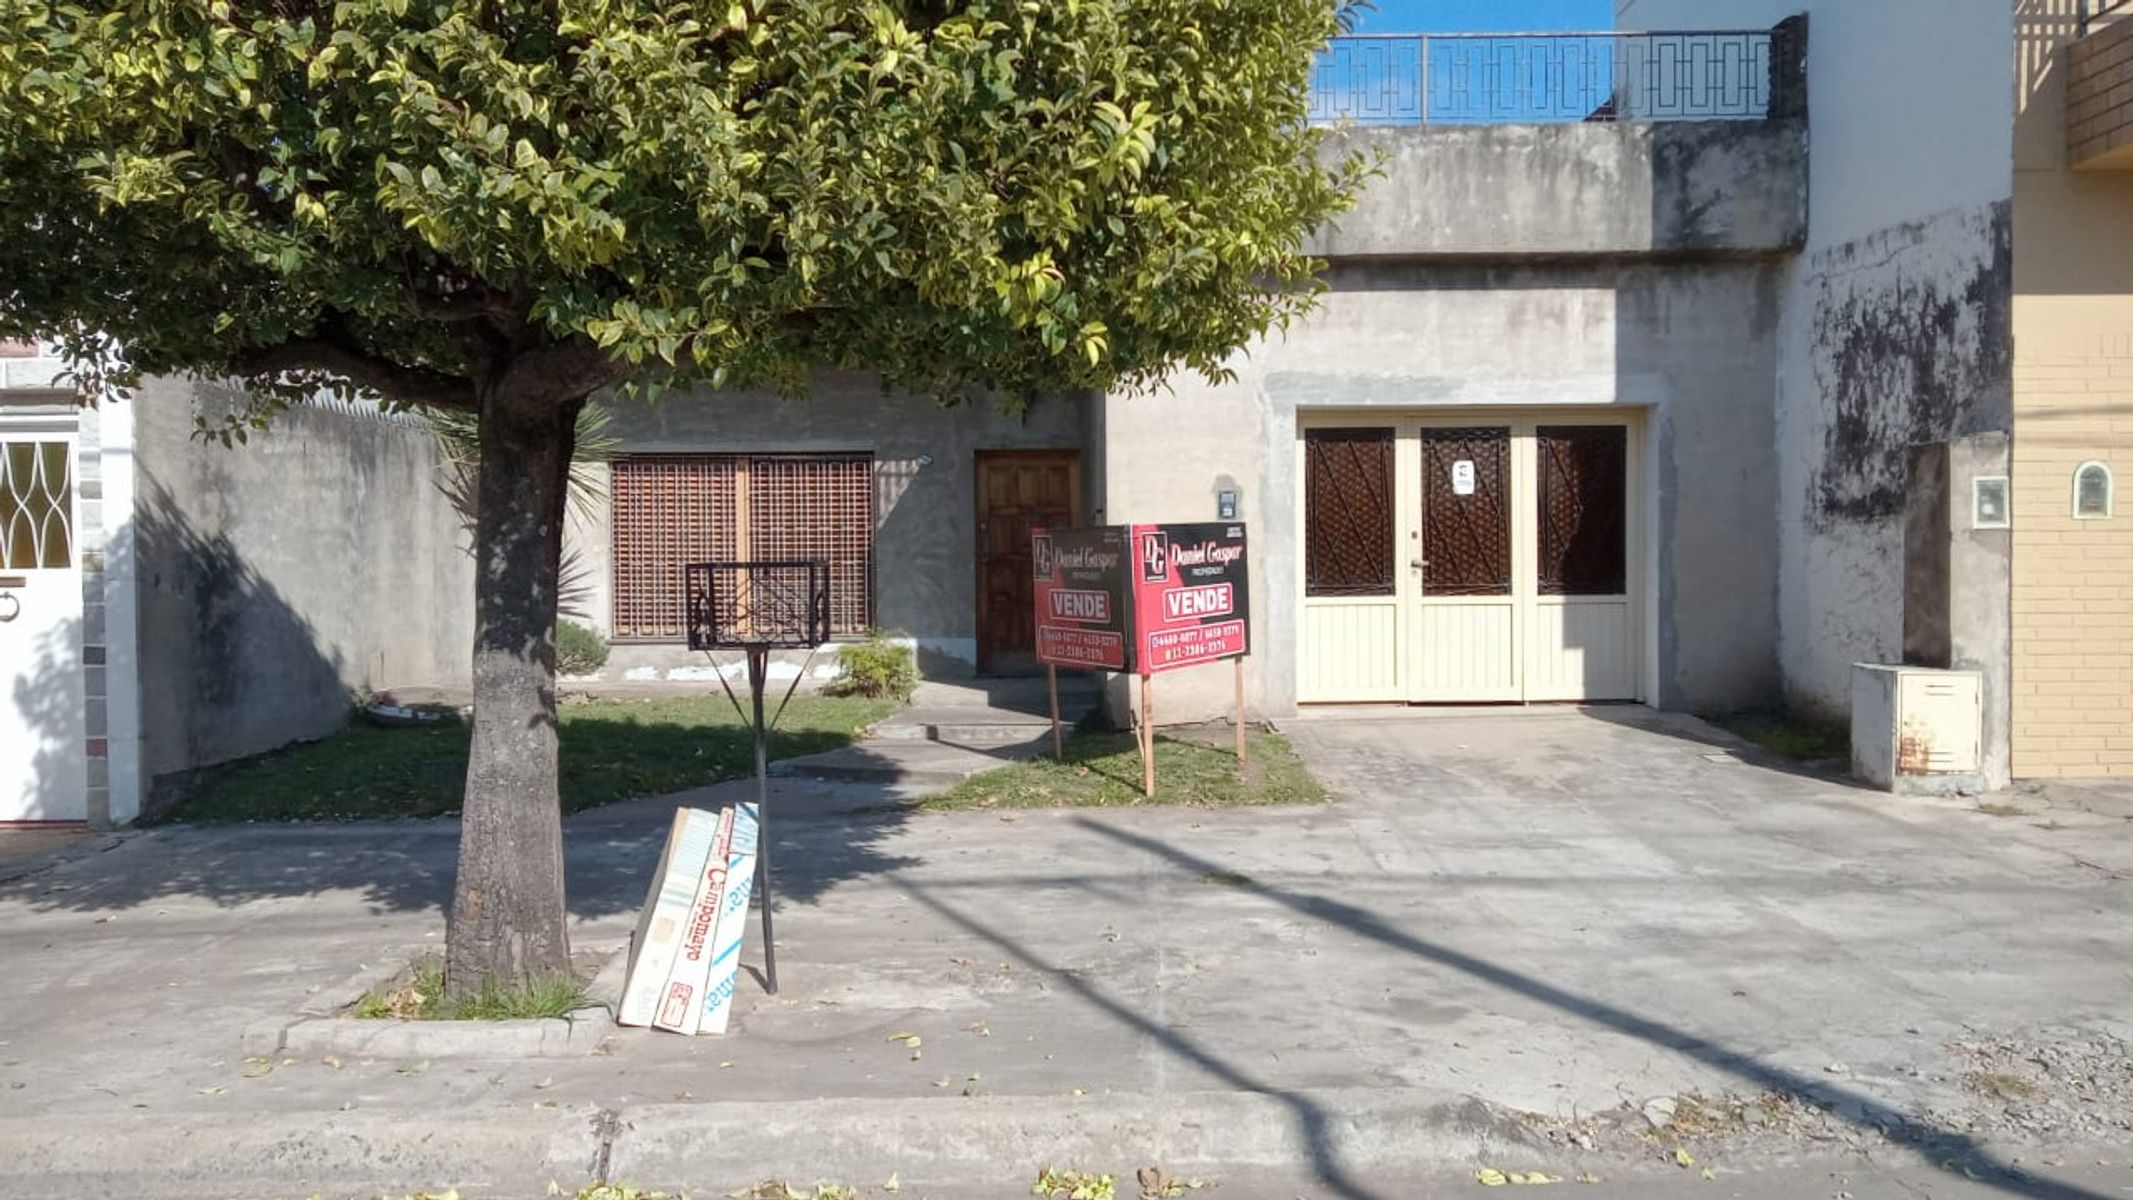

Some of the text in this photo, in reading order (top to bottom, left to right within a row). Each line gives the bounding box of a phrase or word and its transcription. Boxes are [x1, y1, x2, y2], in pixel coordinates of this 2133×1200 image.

[1055, 546, 1119, 575] Daniel Gaspar
[1145, 534, 1165, 575] DG
[1171, 540, 1243, 567] Daniel Gaspar
[1053, 592, 1106, 619] VENDE
[1169, 587, 1229, 617] VENDE
[684, 868, 727, 961] Campomayo
